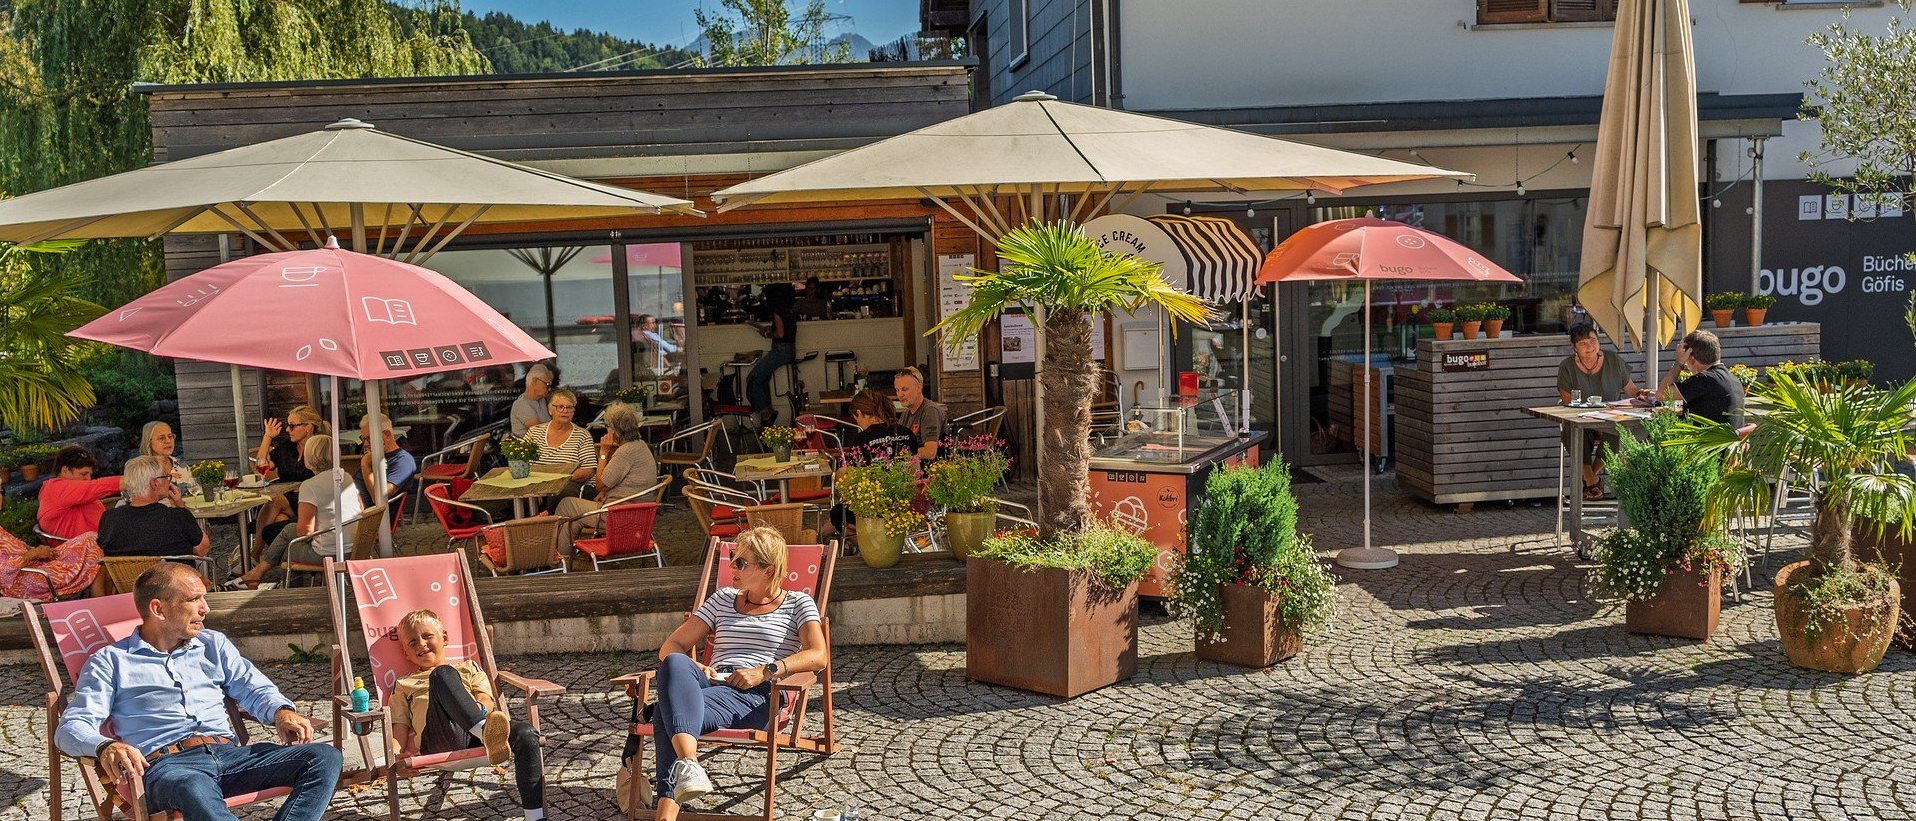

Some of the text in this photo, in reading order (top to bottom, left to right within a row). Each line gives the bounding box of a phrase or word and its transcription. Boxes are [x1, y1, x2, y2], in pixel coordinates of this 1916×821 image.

[1112, 231, 1146, 253] CREAM
[1380, 264, 1413, 275] bugo
[1863, 254, 1916, 272] Büche
[1862, 275, 1905, 293] Göfis
[1446, 354, 1469, 366] bugo
[366, 623, 400, 641] bug
